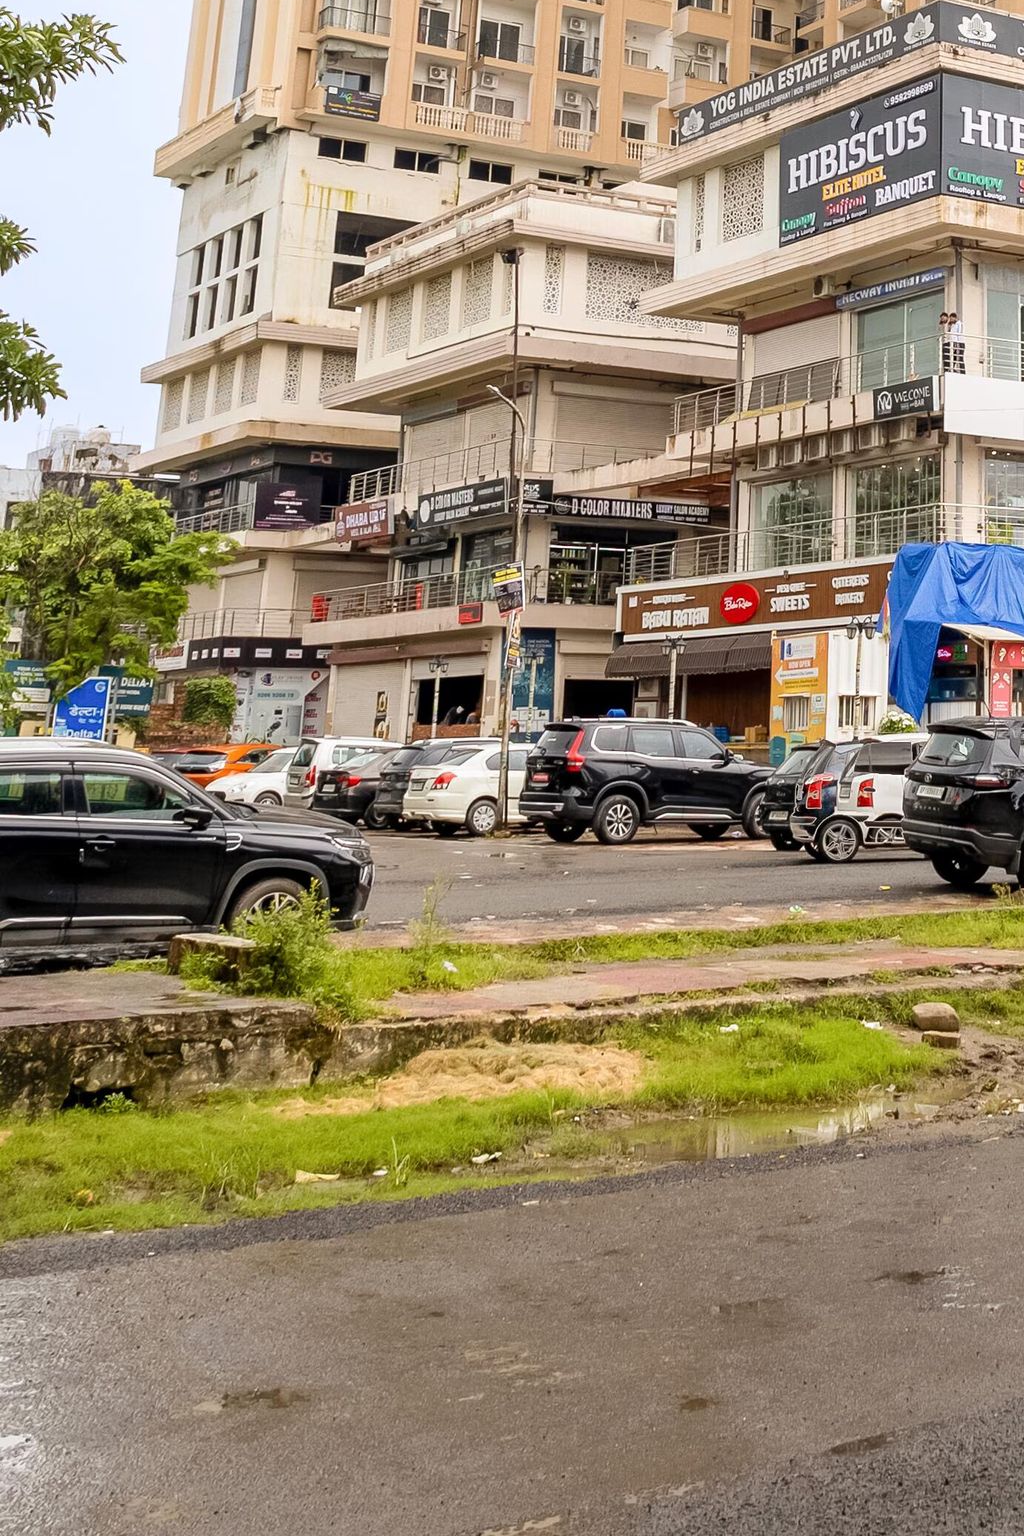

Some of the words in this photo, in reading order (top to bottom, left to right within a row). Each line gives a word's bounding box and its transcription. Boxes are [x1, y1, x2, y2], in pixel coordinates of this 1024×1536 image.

[710, 92, 736, 118] YOG
[739, 76, 775, 105] INDIA
[778, 55, 828, 91] ESTATE
[832, 40, 862, 66] PVT.
[865, 25, 897, 55] LTD.
[709, 112, 740, 130] CONSTRUCTION
[754, 98, 770, 113] ESTATE
[770, 91, 793, 109] COMPANY
[788, 109, 927, 193] HIBISCUS
[822, 178, 851, 201] ELITE
[875, 170, 936, 206] BANQUET
[948, 166, 1004, 192] Canopy
[949, 184, 975, 197] Rooftop
[983, 190, 1007, 201] Lounge
[451, 488, 474, 505] MASTERS
[571, 498, 578, 514] D
[580, 499, 610, 516] COLOR
[346, 512, 368, 528] DHABA
[770, 594, 810, 612] SWEETS
[673, 606, 709, 628] RATAN
